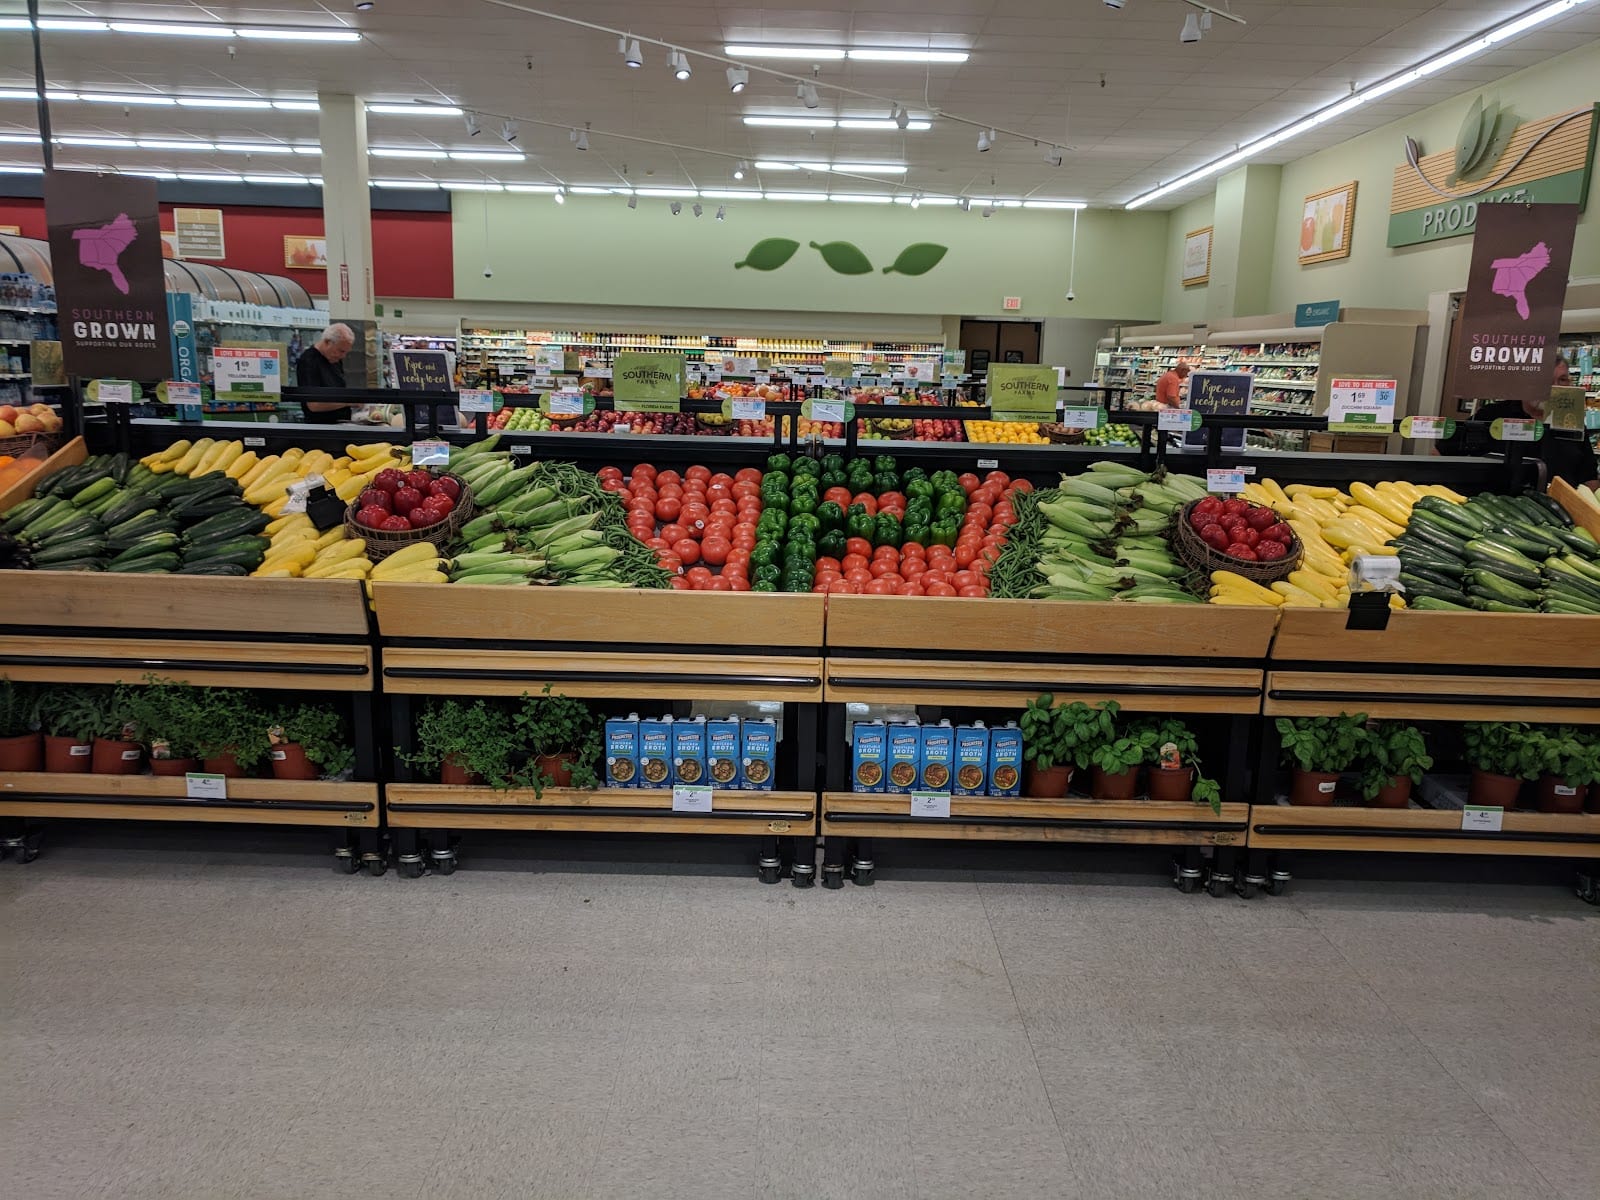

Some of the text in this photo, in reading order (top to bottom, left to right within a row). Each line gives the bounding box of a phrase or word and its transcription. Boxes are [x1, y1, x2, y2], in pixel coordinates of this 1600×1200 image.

[72, 309, 153, 320] SOUTHERN
[74, 322, 156, 340] GROWN
[1473, 334, 1545, 345] SOUTHERN
[1470, 347, 1543, 363] GROWN
[404, 355, 424, 375] Ripe
[623, 370, 671, 381] SOUTHERN
[1001, 382, 1048, 392] SOUTHERN
[1202, 378, 1223, 398] Ripe
